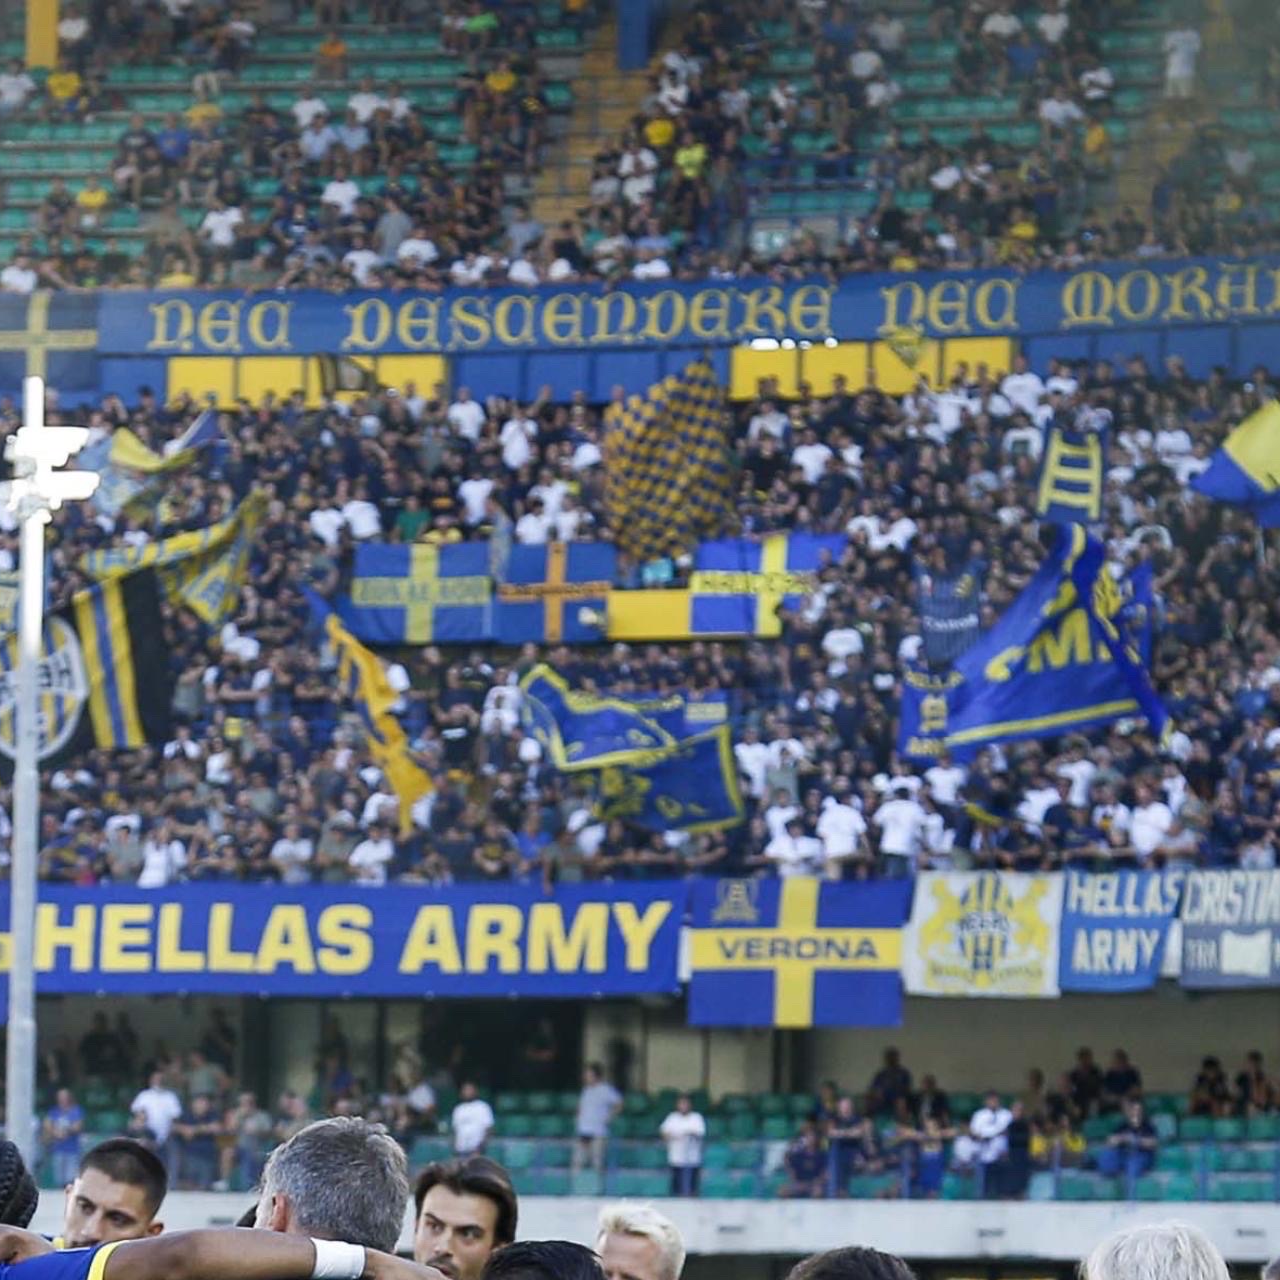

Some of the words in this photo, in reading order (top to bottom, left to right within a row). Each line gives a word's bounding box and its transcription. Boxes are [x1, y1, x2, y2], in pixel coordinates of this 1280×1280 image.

[1068, 869, 1180, 916] HELLAS
[34, 901, 373, 975] HELLAS
[399, 899, 672, 974] ARMY
[719, 934, 880, 962] VERONA
[1073, 927, 1162, 973] ARMY
